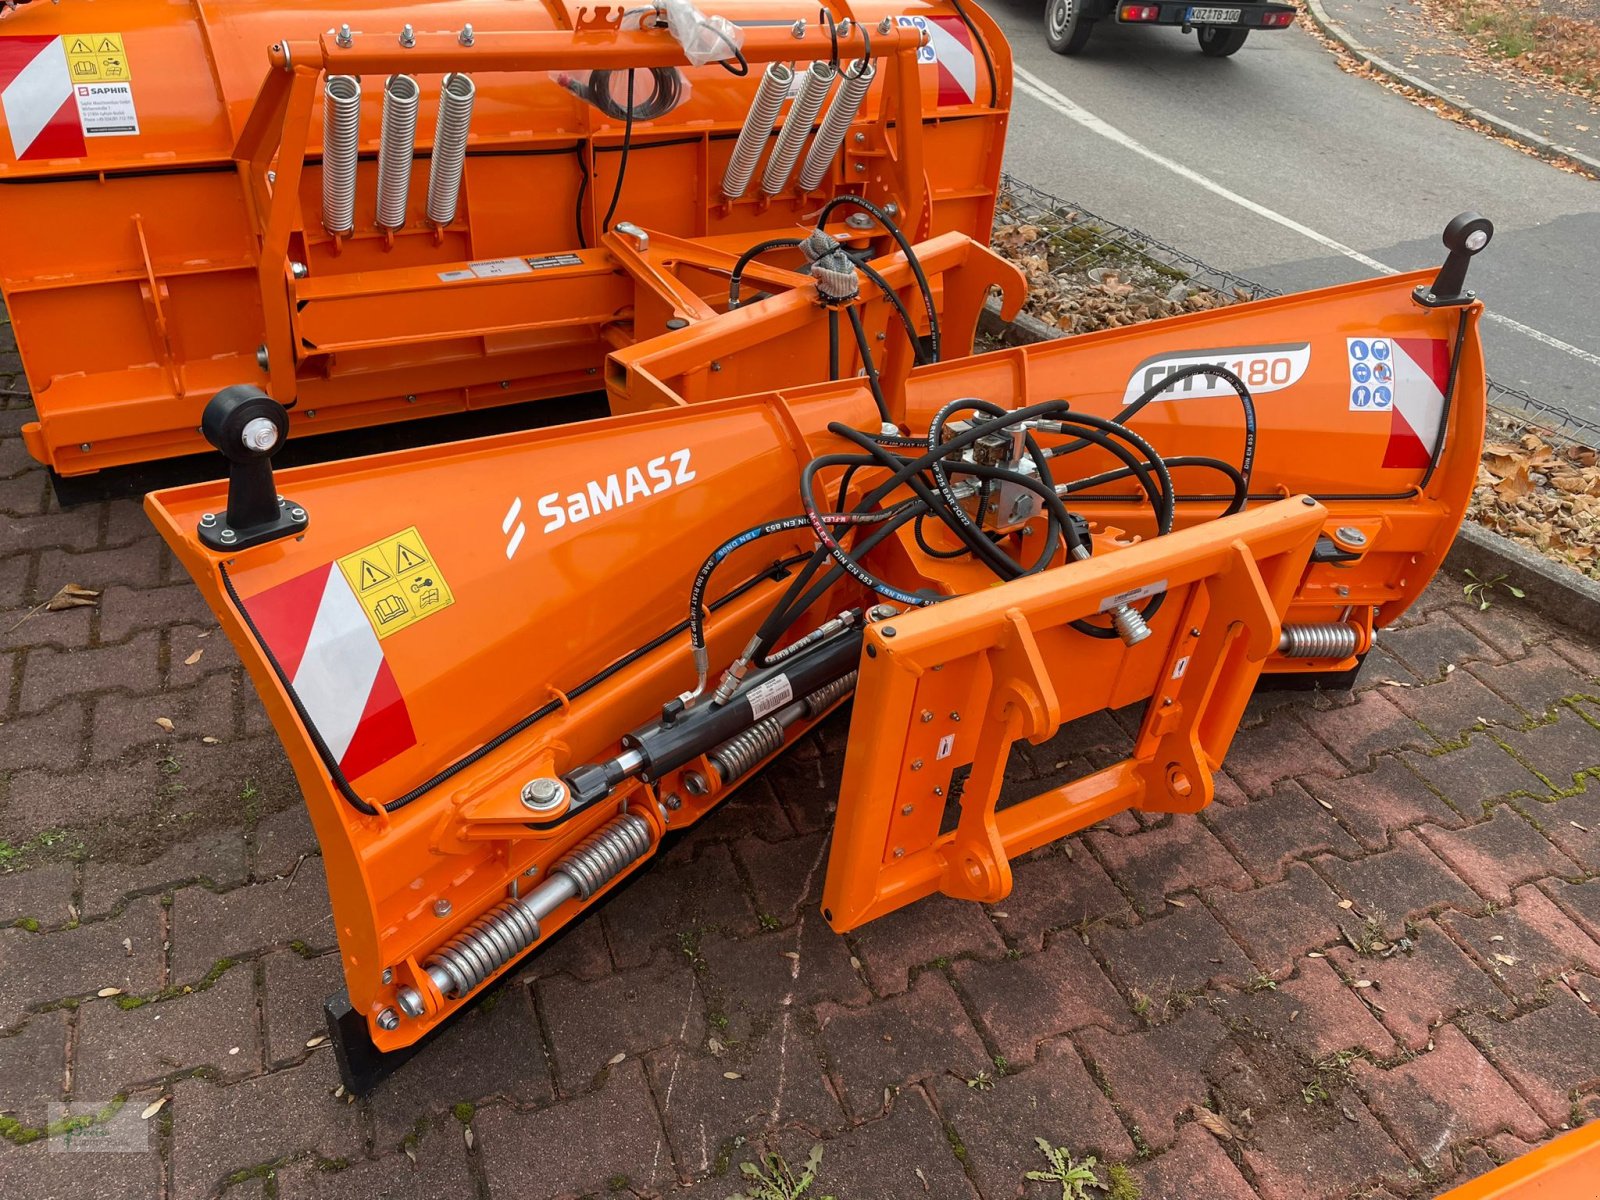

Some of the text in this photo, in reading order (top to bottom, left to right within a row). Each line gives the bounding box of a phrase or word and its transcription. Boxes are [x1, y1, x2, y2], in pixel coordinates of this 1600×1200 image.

[1213, 9, 1223, 20] TB
[1223, 10, 1239, 21] 100
[1143, 357, 1292, 393] CITY 180
[537, 447, 697, 534] SaMASZ
[935, 473, 946, 487] 225
[942, 488, 955, 505] BAR
[953, 505, 970, 526] 2Q/22
[765, 524, 782, 533] 853
[783, 519, 796, 528] EN
[808, 511, 830, 544] M-FLEX
[833, 549, 848, 565] DIN
[846, 563, 859, 575] EN
[858, 573, 873, 586] 853
[880, 587, 895, 598] 1SN
[701, 560, 714, 575] SAE
[695, 575, 705, 587] 100
